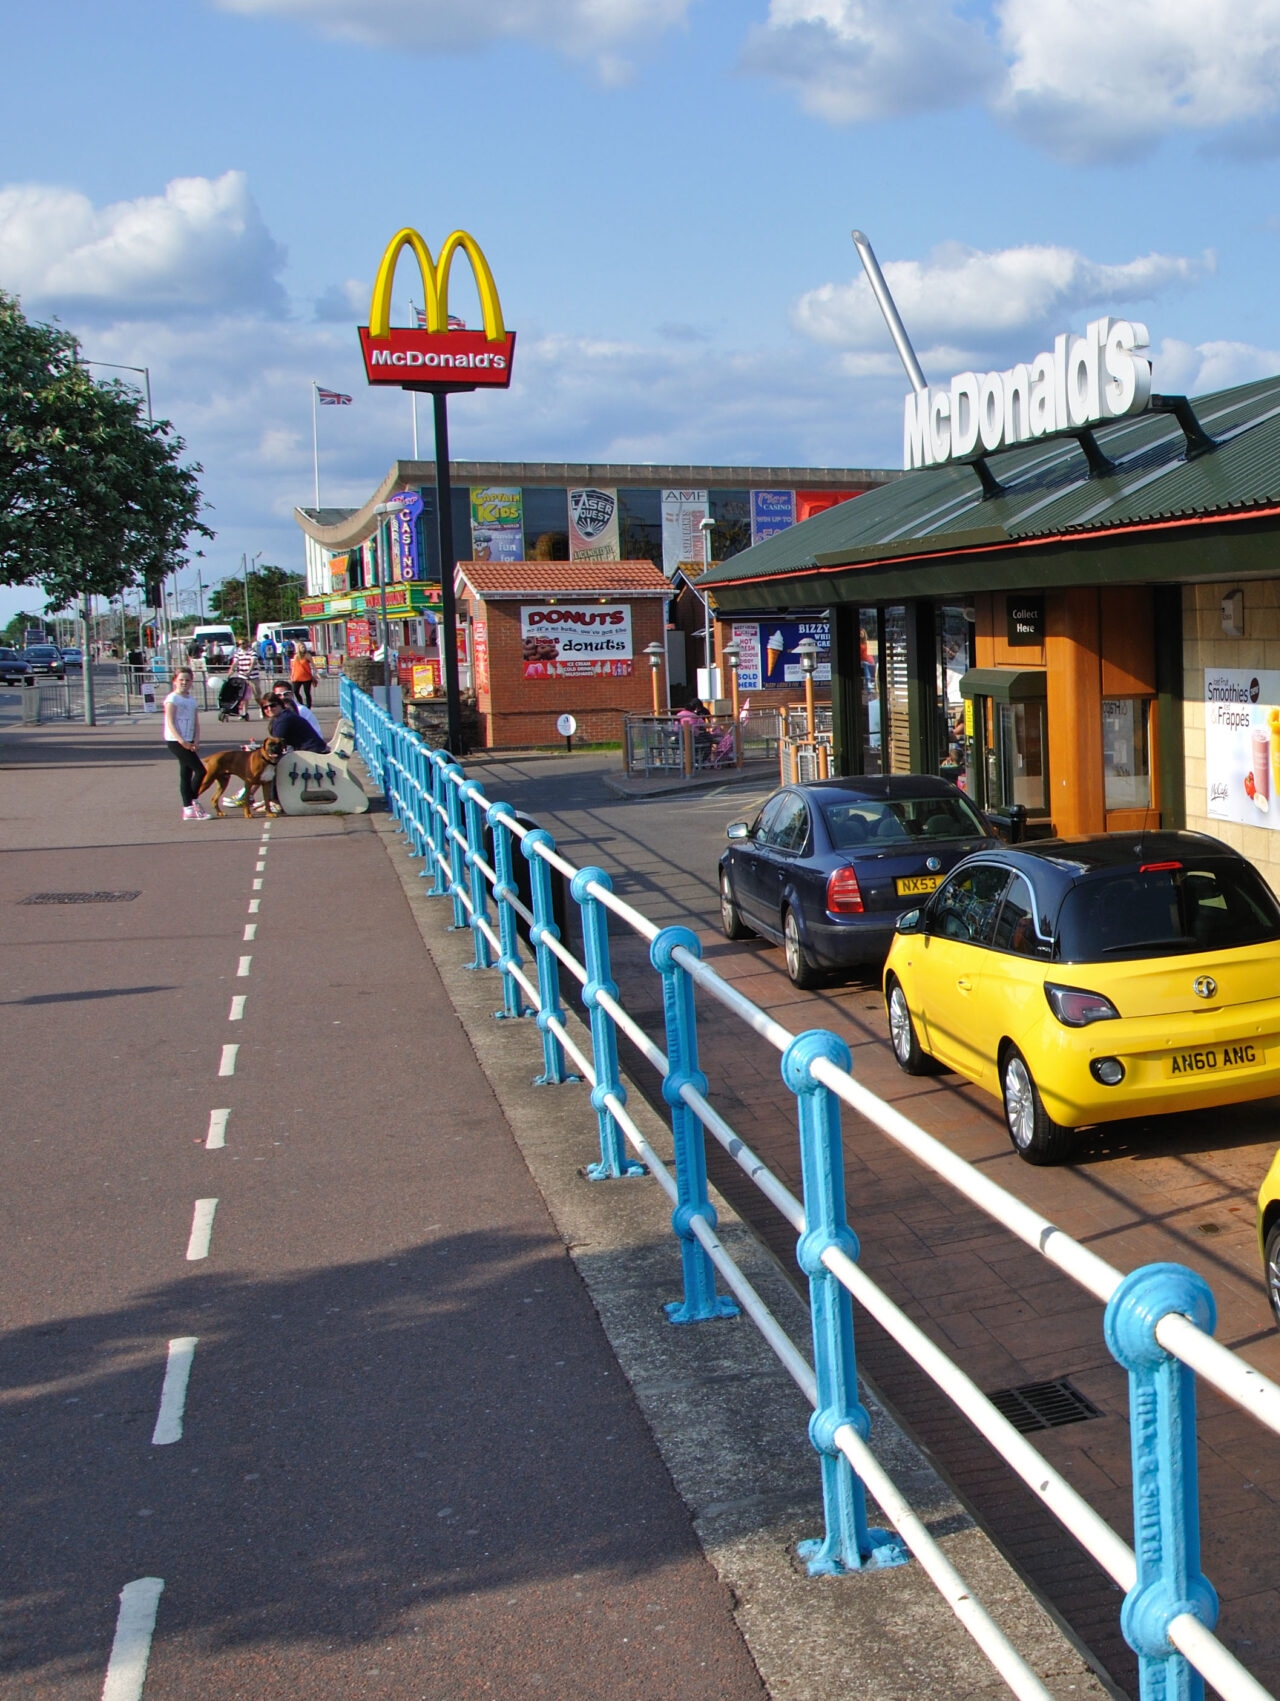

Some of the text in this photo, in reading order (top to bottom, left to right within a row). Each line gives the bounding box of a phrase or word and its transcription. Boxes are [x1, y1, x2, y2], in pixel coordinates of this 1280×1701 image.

[371, 350, 506, 369] McDonald's
[904, 316, 1151, 471] McDonald's
[572, 492, 613, 516] LASER
[665, 491, 706, 501] AMF
[477, 504, 519, 522] KIDS
[580, 508, 610, 522] QUEST
[400, 509, 413, 579] CASINO
[498, 543, 517, 551] fun
[528, 610, 625, 626] DONUTS
[1012, 609, 1038, 619] Collect
[798, 623, 830, 634] BIZZY
[1016, 623, 1035, 633] Here
[562, 639, 626, 652] donuts
[1208, 682, 1249, 703] Smoothies
[1217, 705, 1250, 731] Frappés
[902, 877, 937, 892] NX53
[1171, 1045, 1256, 1074] AN60 ANG
